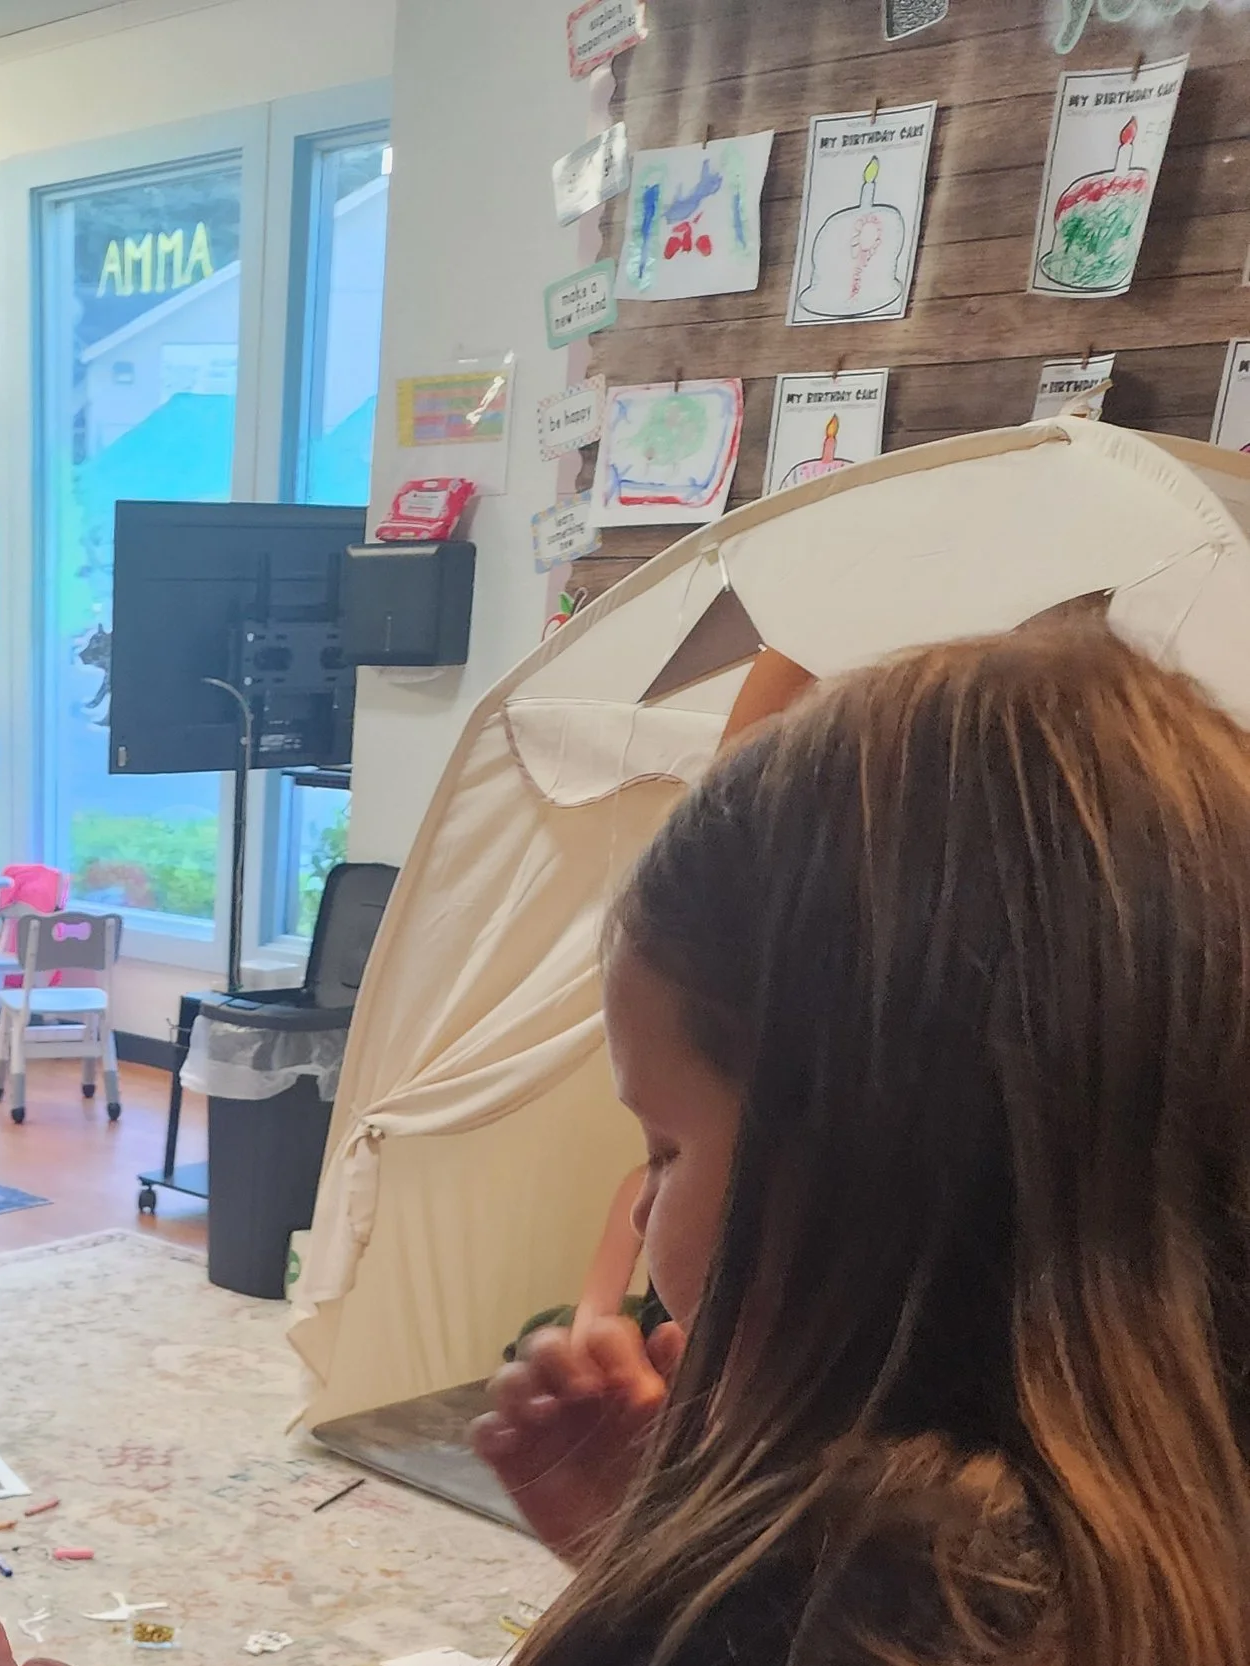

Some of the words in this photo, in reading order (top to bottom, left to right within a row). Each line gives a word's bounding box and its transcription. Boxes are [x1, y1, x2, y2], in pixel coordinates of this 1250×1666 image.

[1068, 94, 1090, 107] MY
[1094, 87, 1155, 106] BIRTHDAY
[819, 137, 838, 149] MY
[841, 129, 897, 147] BIRTHDAY
[899, 124, 925, 141] CAKE
[561, 282, 587, 306] make
[590, 282, 598, 294] a
[554, 313, 573, 330] new
[575, 291, 607, 320] friend
[786, 393, 803, 404] MY
[806, 390, 852, 403] BIRTHDAY
[855, 388, 879, 400] CAKE
[549, 416, 561, 432] be
[564, 405, 592, 428] happy
[546, 521, 586, 546] something
[559, 539, 575, 552] new
